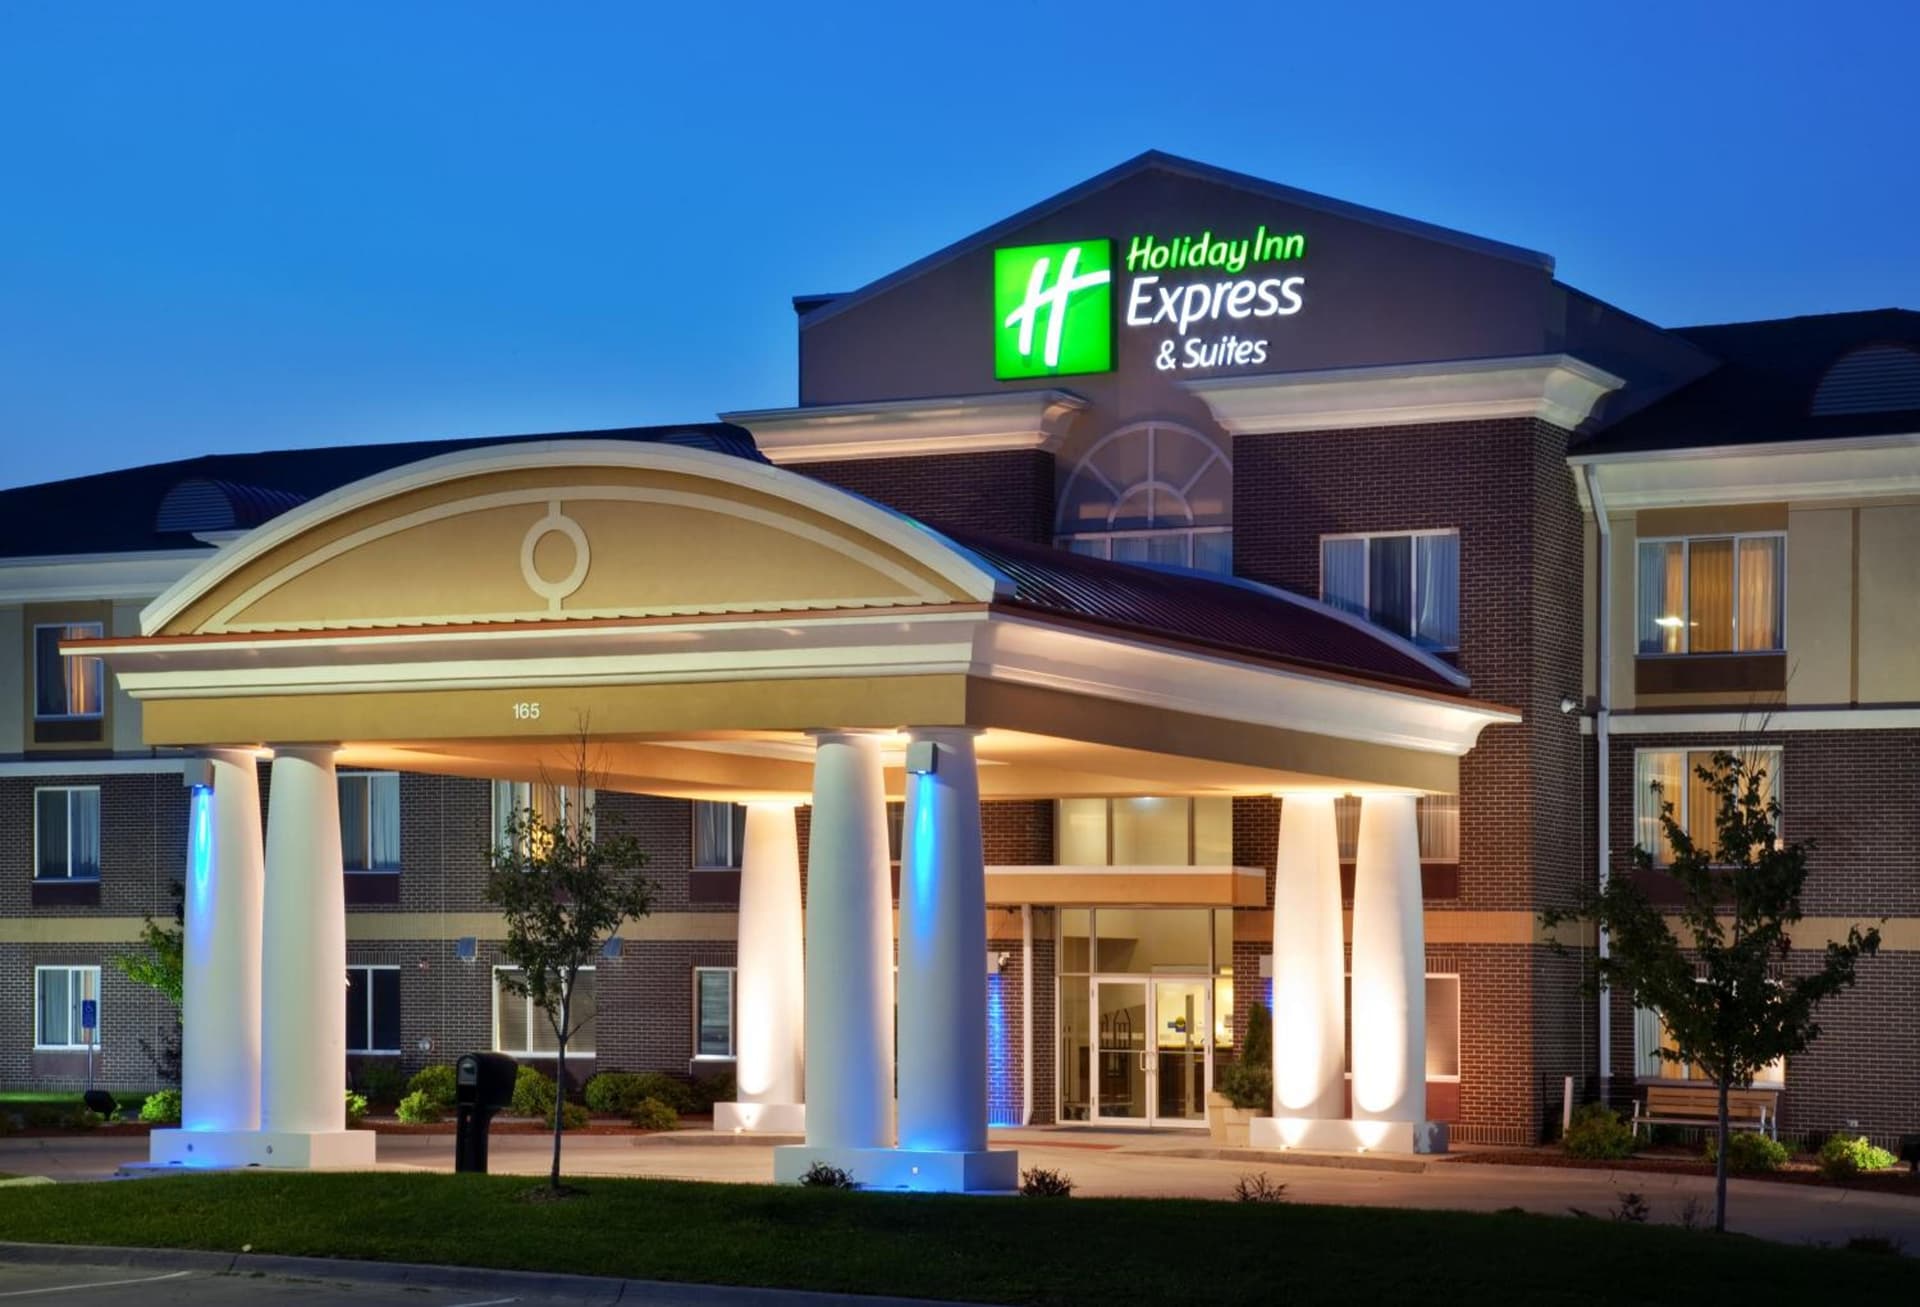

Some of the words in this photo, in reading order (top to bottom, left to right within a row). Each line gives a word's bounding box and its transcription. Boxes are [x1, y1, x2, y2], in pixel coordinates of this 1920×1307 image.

[1126, 231, 1248, 273] Holiday
[1253, 225, 1305, 262] Inn
[1005, 247, 1110, 366] H
[1126, 275, 1305, 335] Express
[1155, 339, 1177, 371] &
[1181, 336, 1268, 370] Suites
[512, 702, 541, 720] 165
